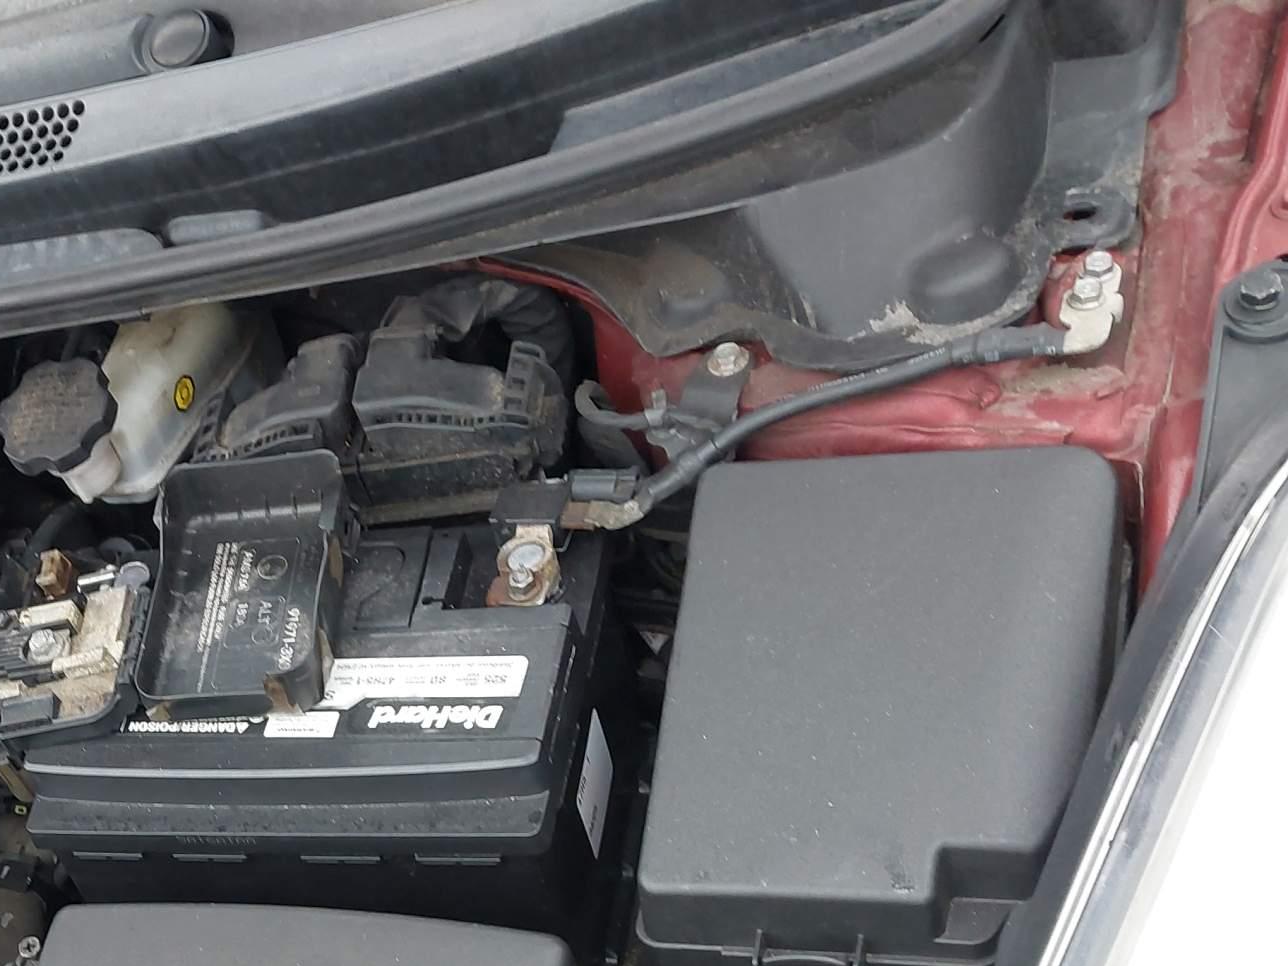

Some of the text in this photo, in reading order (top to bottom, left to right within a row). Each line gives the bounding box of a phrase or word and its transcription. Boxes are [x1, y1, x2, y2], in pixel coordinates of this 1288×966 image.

[257, 600, 272, 624] ALT
[128, 721, 235, 733] DANGER/POISON
[367, 705, 504, 729] DieHard
